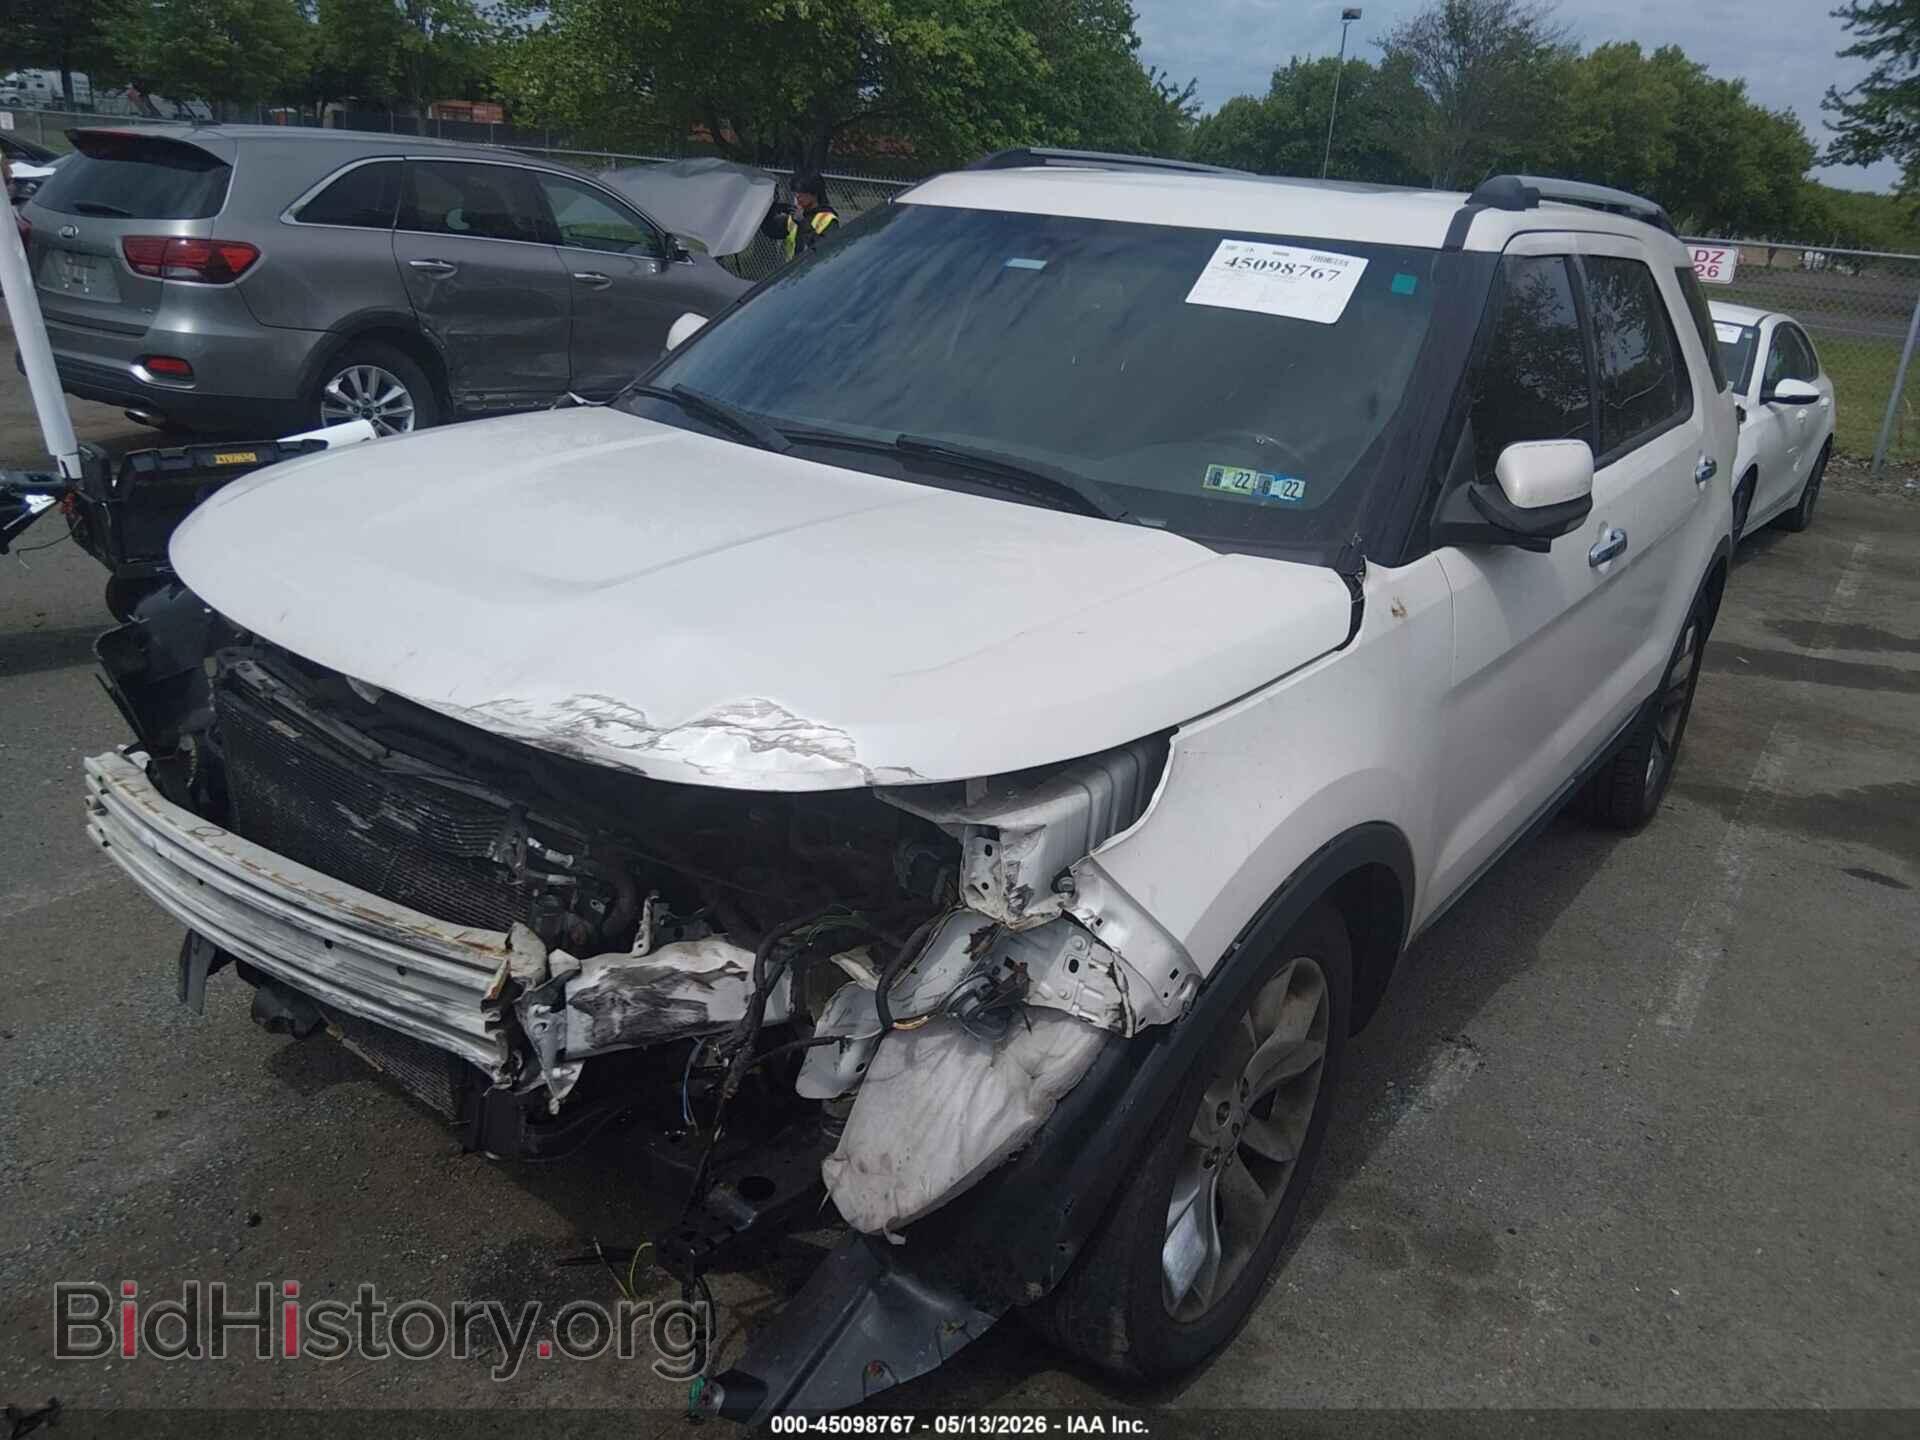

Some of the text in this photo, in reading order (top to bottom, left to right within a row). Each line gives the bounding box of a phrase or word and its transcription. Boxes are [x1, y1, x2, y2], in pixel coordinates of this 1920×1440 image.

[1694, 249, 1725, 264] DZ
[1224, 256, 1341, 282] 45098767
[1695, 264, 1719, 278] 26
[1235, 472, 1250, 489] 22
[1284, 481, 1300, 498] 22
